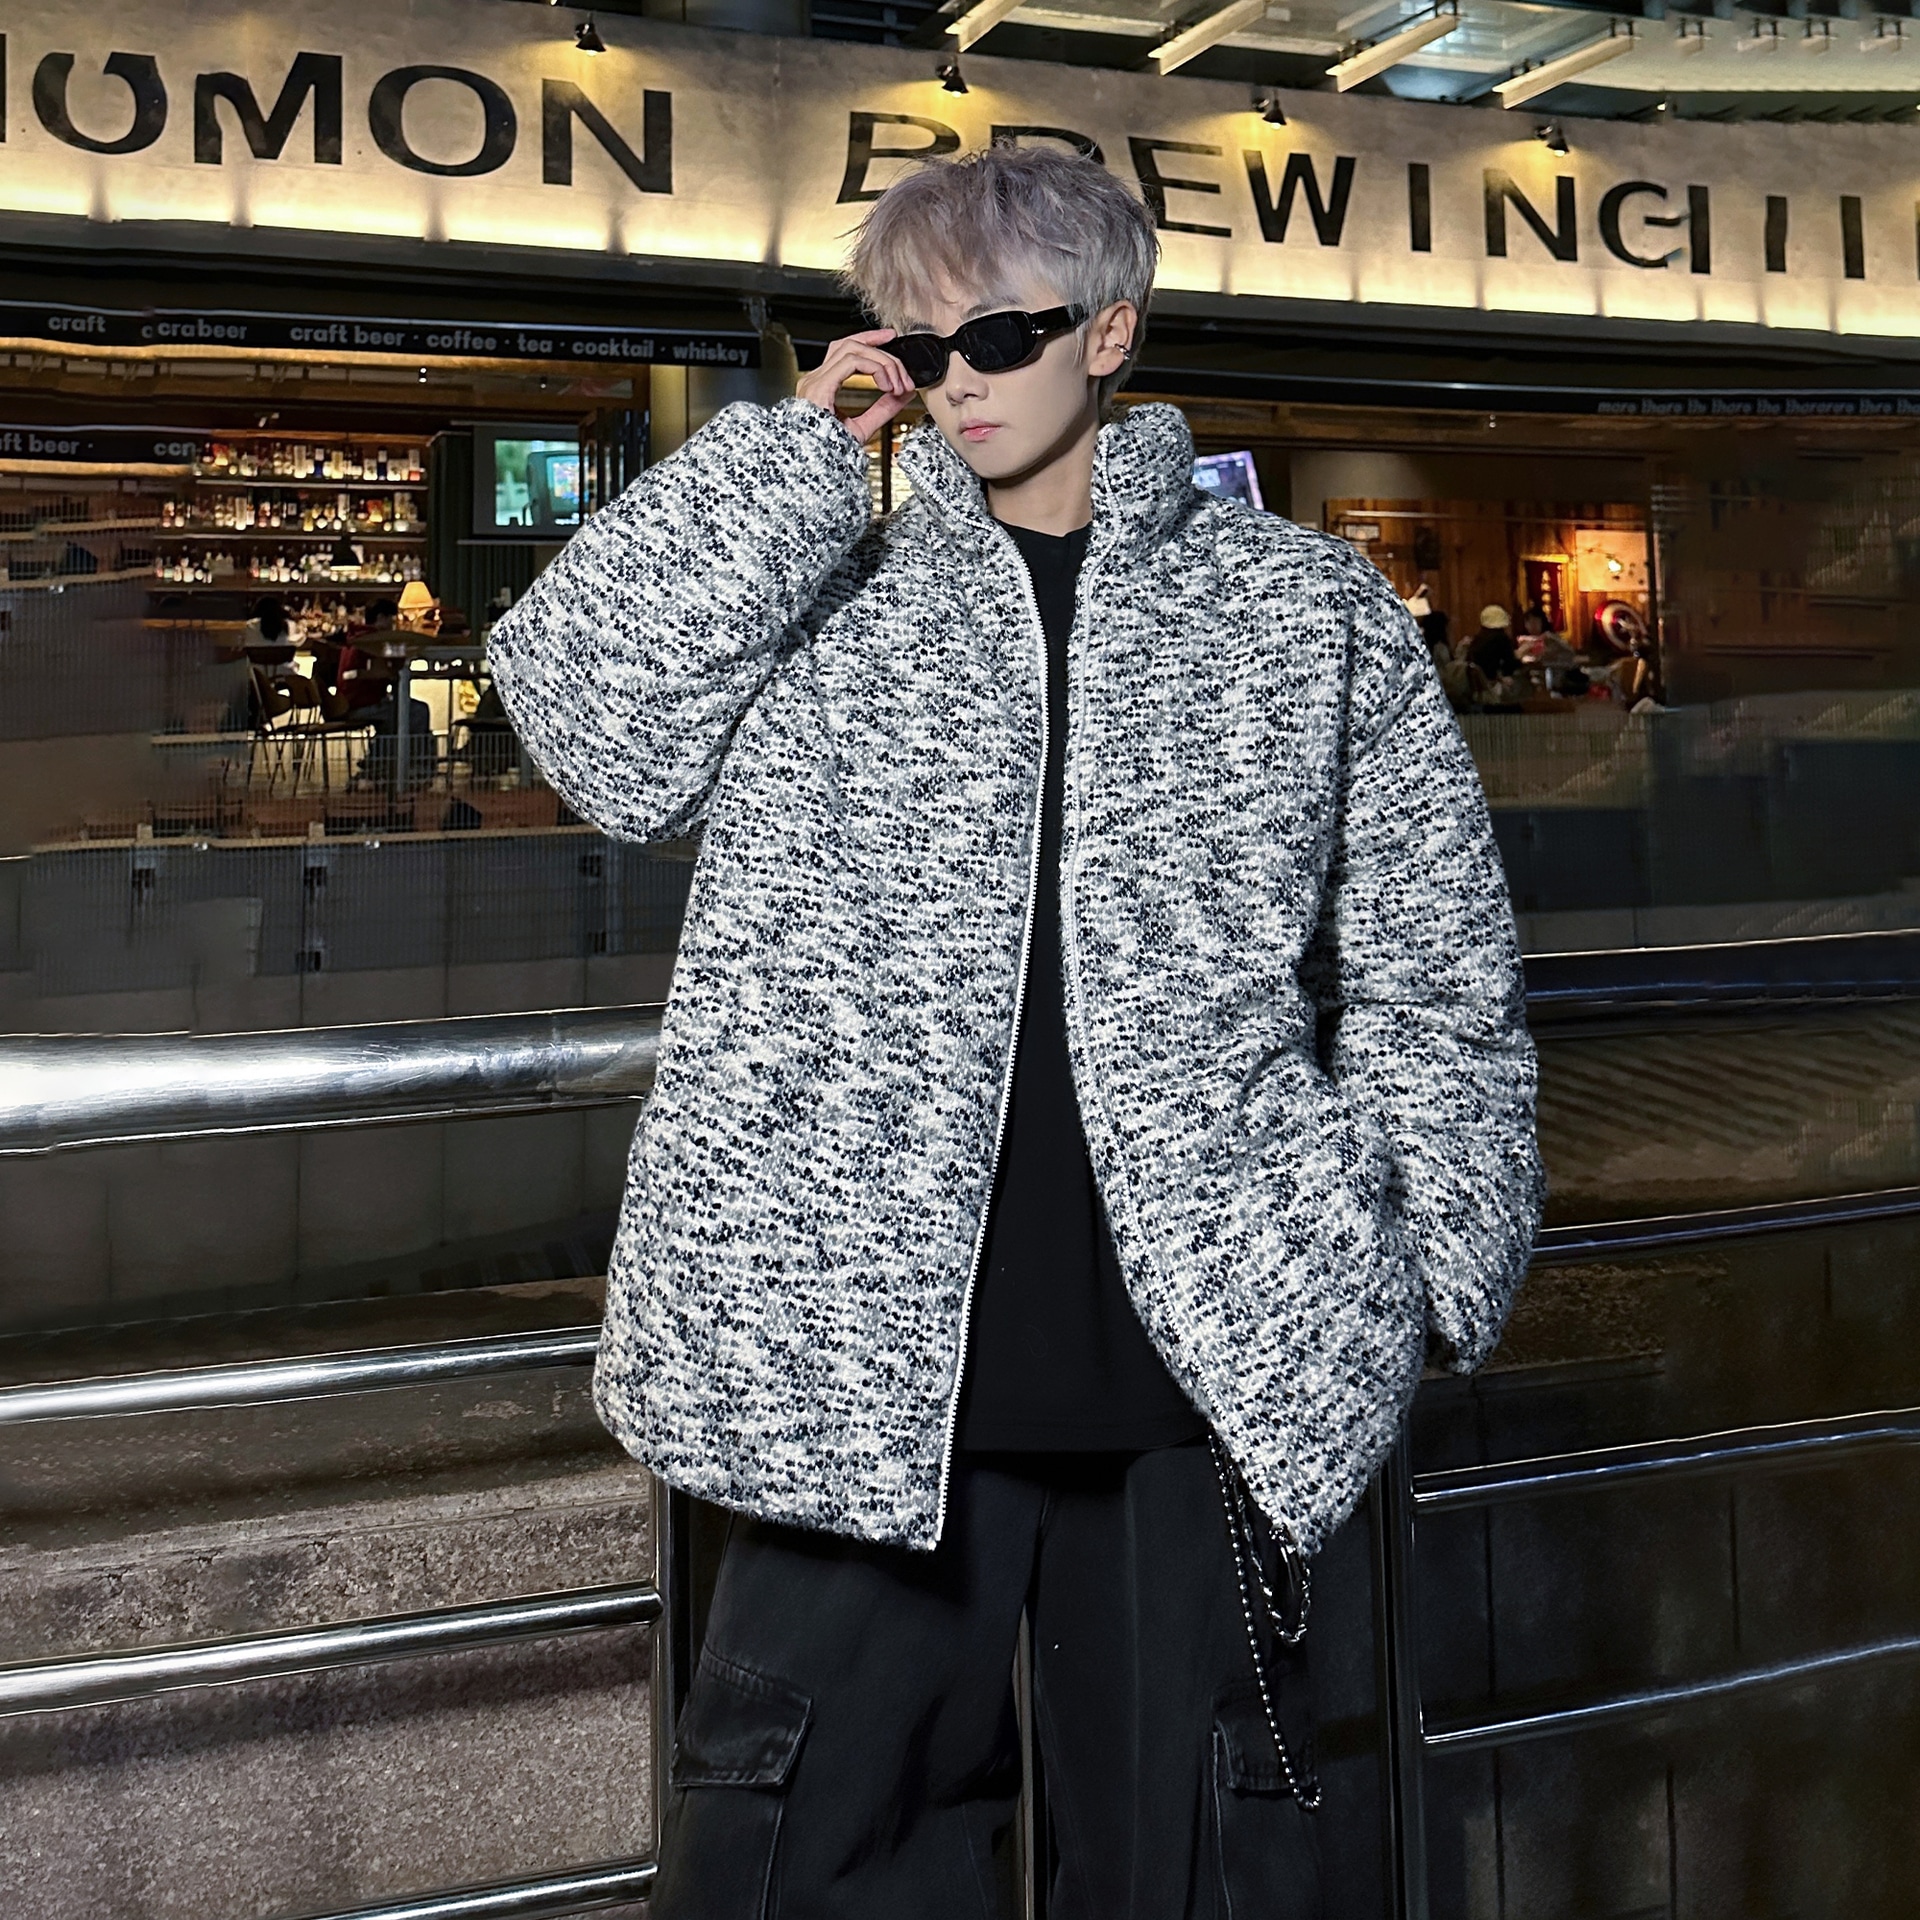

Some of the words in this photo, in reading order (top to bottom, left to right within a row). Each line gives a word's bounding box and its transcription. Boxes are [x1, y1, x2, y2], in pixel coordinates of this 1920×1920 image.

[48, 315, 106, 333] craft
[290, 324, 348, 343] craft
[354, 325, 405, 346] beer
[426, 330, 497, 350] coffee
[517, 333, 553, 353] tea
[572, 338, 654, 358] cocktail
[673, 341, 749, 366] whiskey
[28, 433, 80, 455] beer
